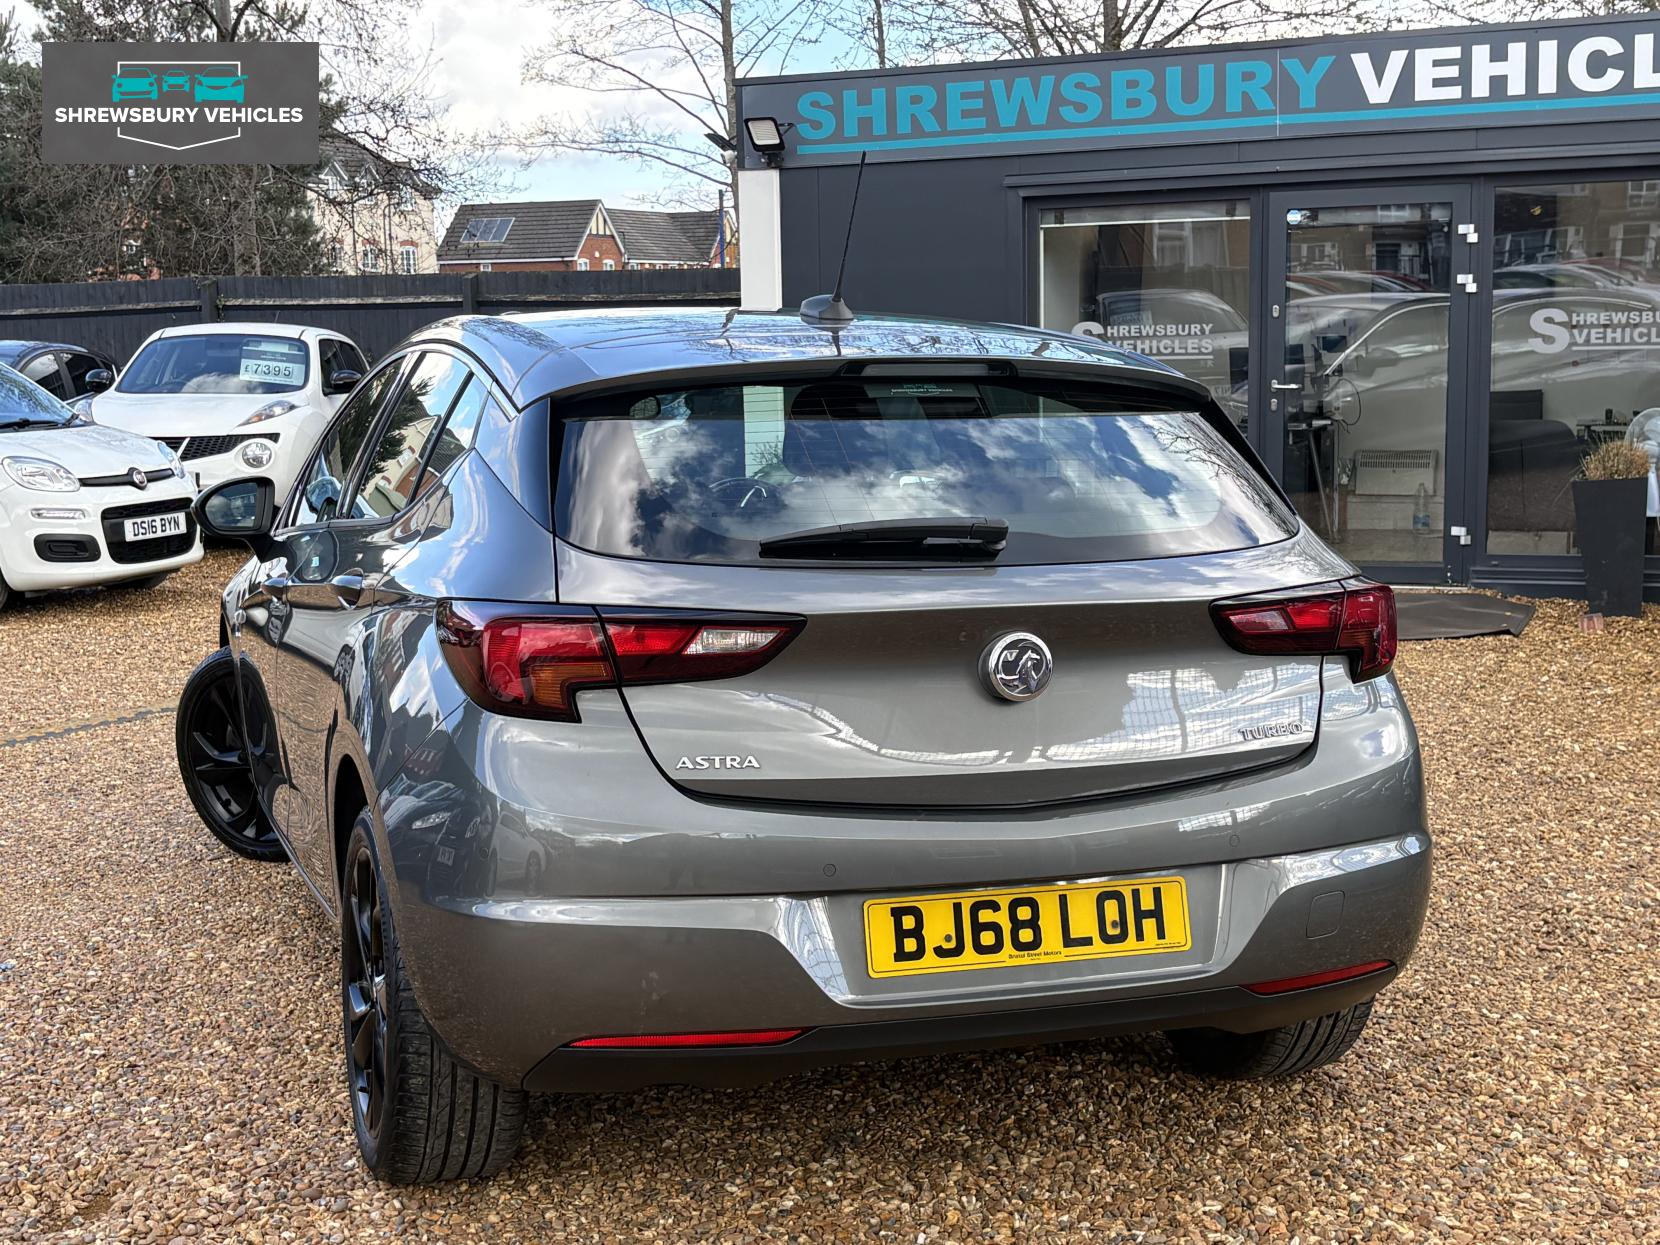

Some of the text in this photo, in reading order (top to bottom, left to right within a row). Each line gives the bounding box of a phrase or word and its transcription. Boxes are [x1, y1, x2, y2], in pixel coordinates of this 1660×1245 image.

[797, 33, 1660, 140] SHREWSBURY VEHICL
[132, 516, 180, 537] DS16 BYN
[1238, 722, 1303, 741] TURBO
[676, 755, 760, 769] ASTRA
[890, 886, 1166, 962] BJ68 LOH
